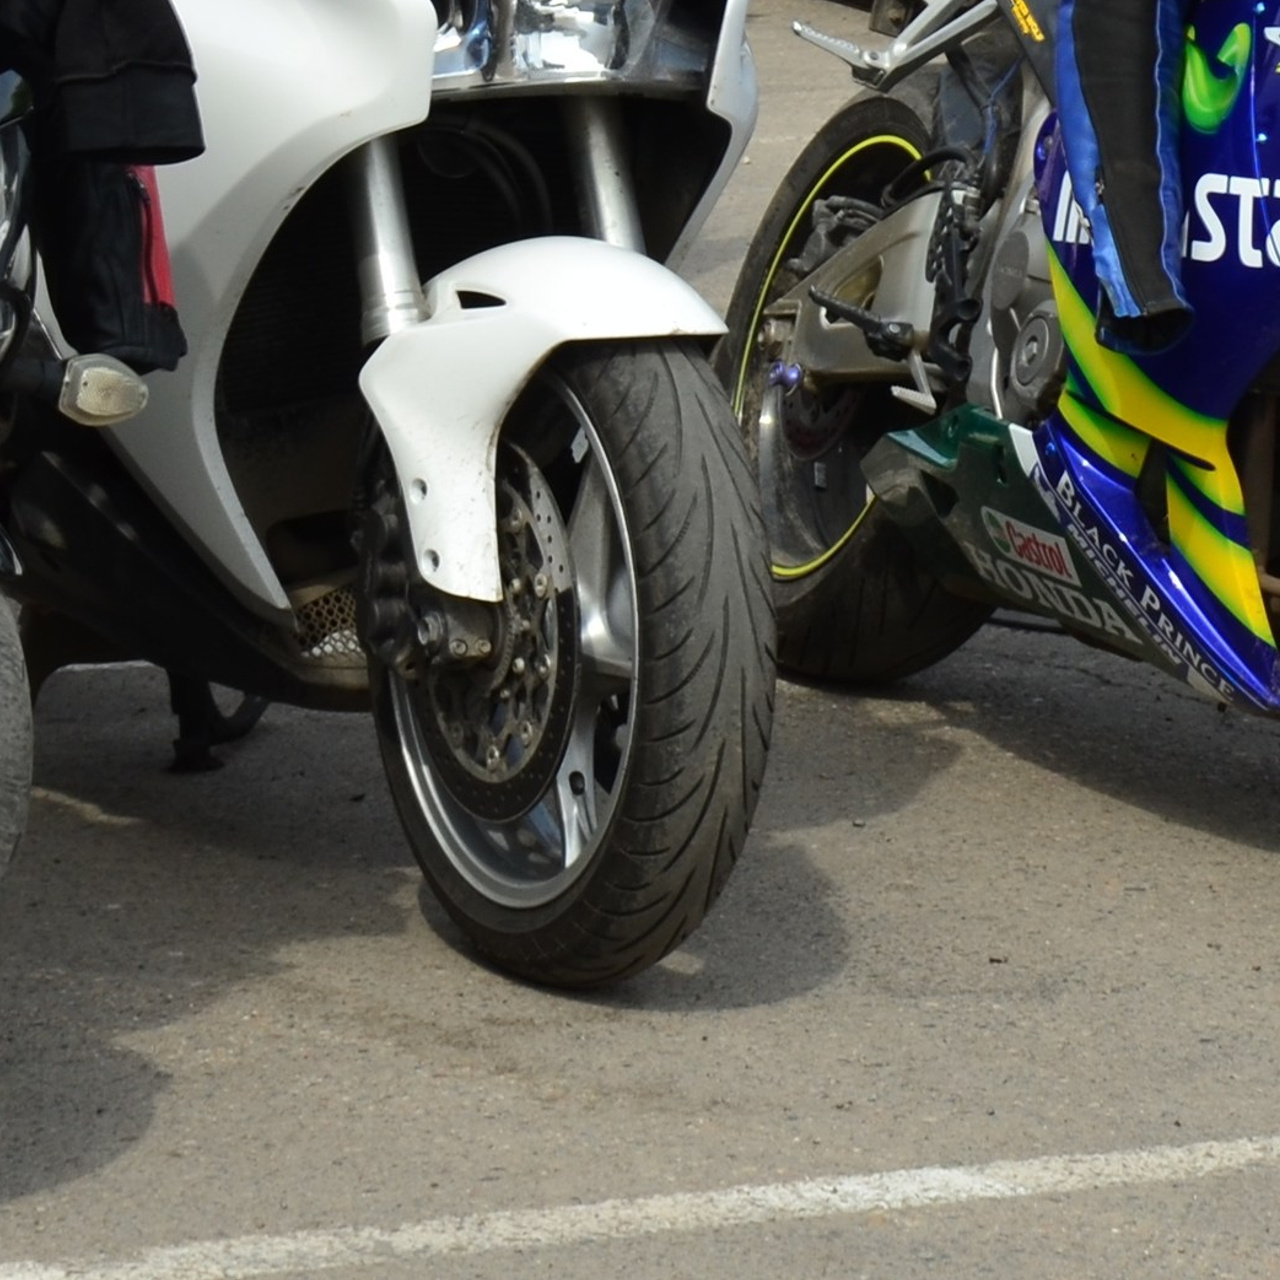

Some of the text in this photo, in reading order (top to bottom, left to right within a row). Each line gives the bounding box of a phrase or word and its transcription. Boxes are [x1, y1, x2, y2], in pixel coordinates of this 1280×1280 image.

[962, 540, 1144, 646] HONDA
[1004, 520, 1073, 580] Castrol
[1055, 469, 1236, 702] BLACK PRINCE
[1066, 523, 1184, 665] MICHELIN
